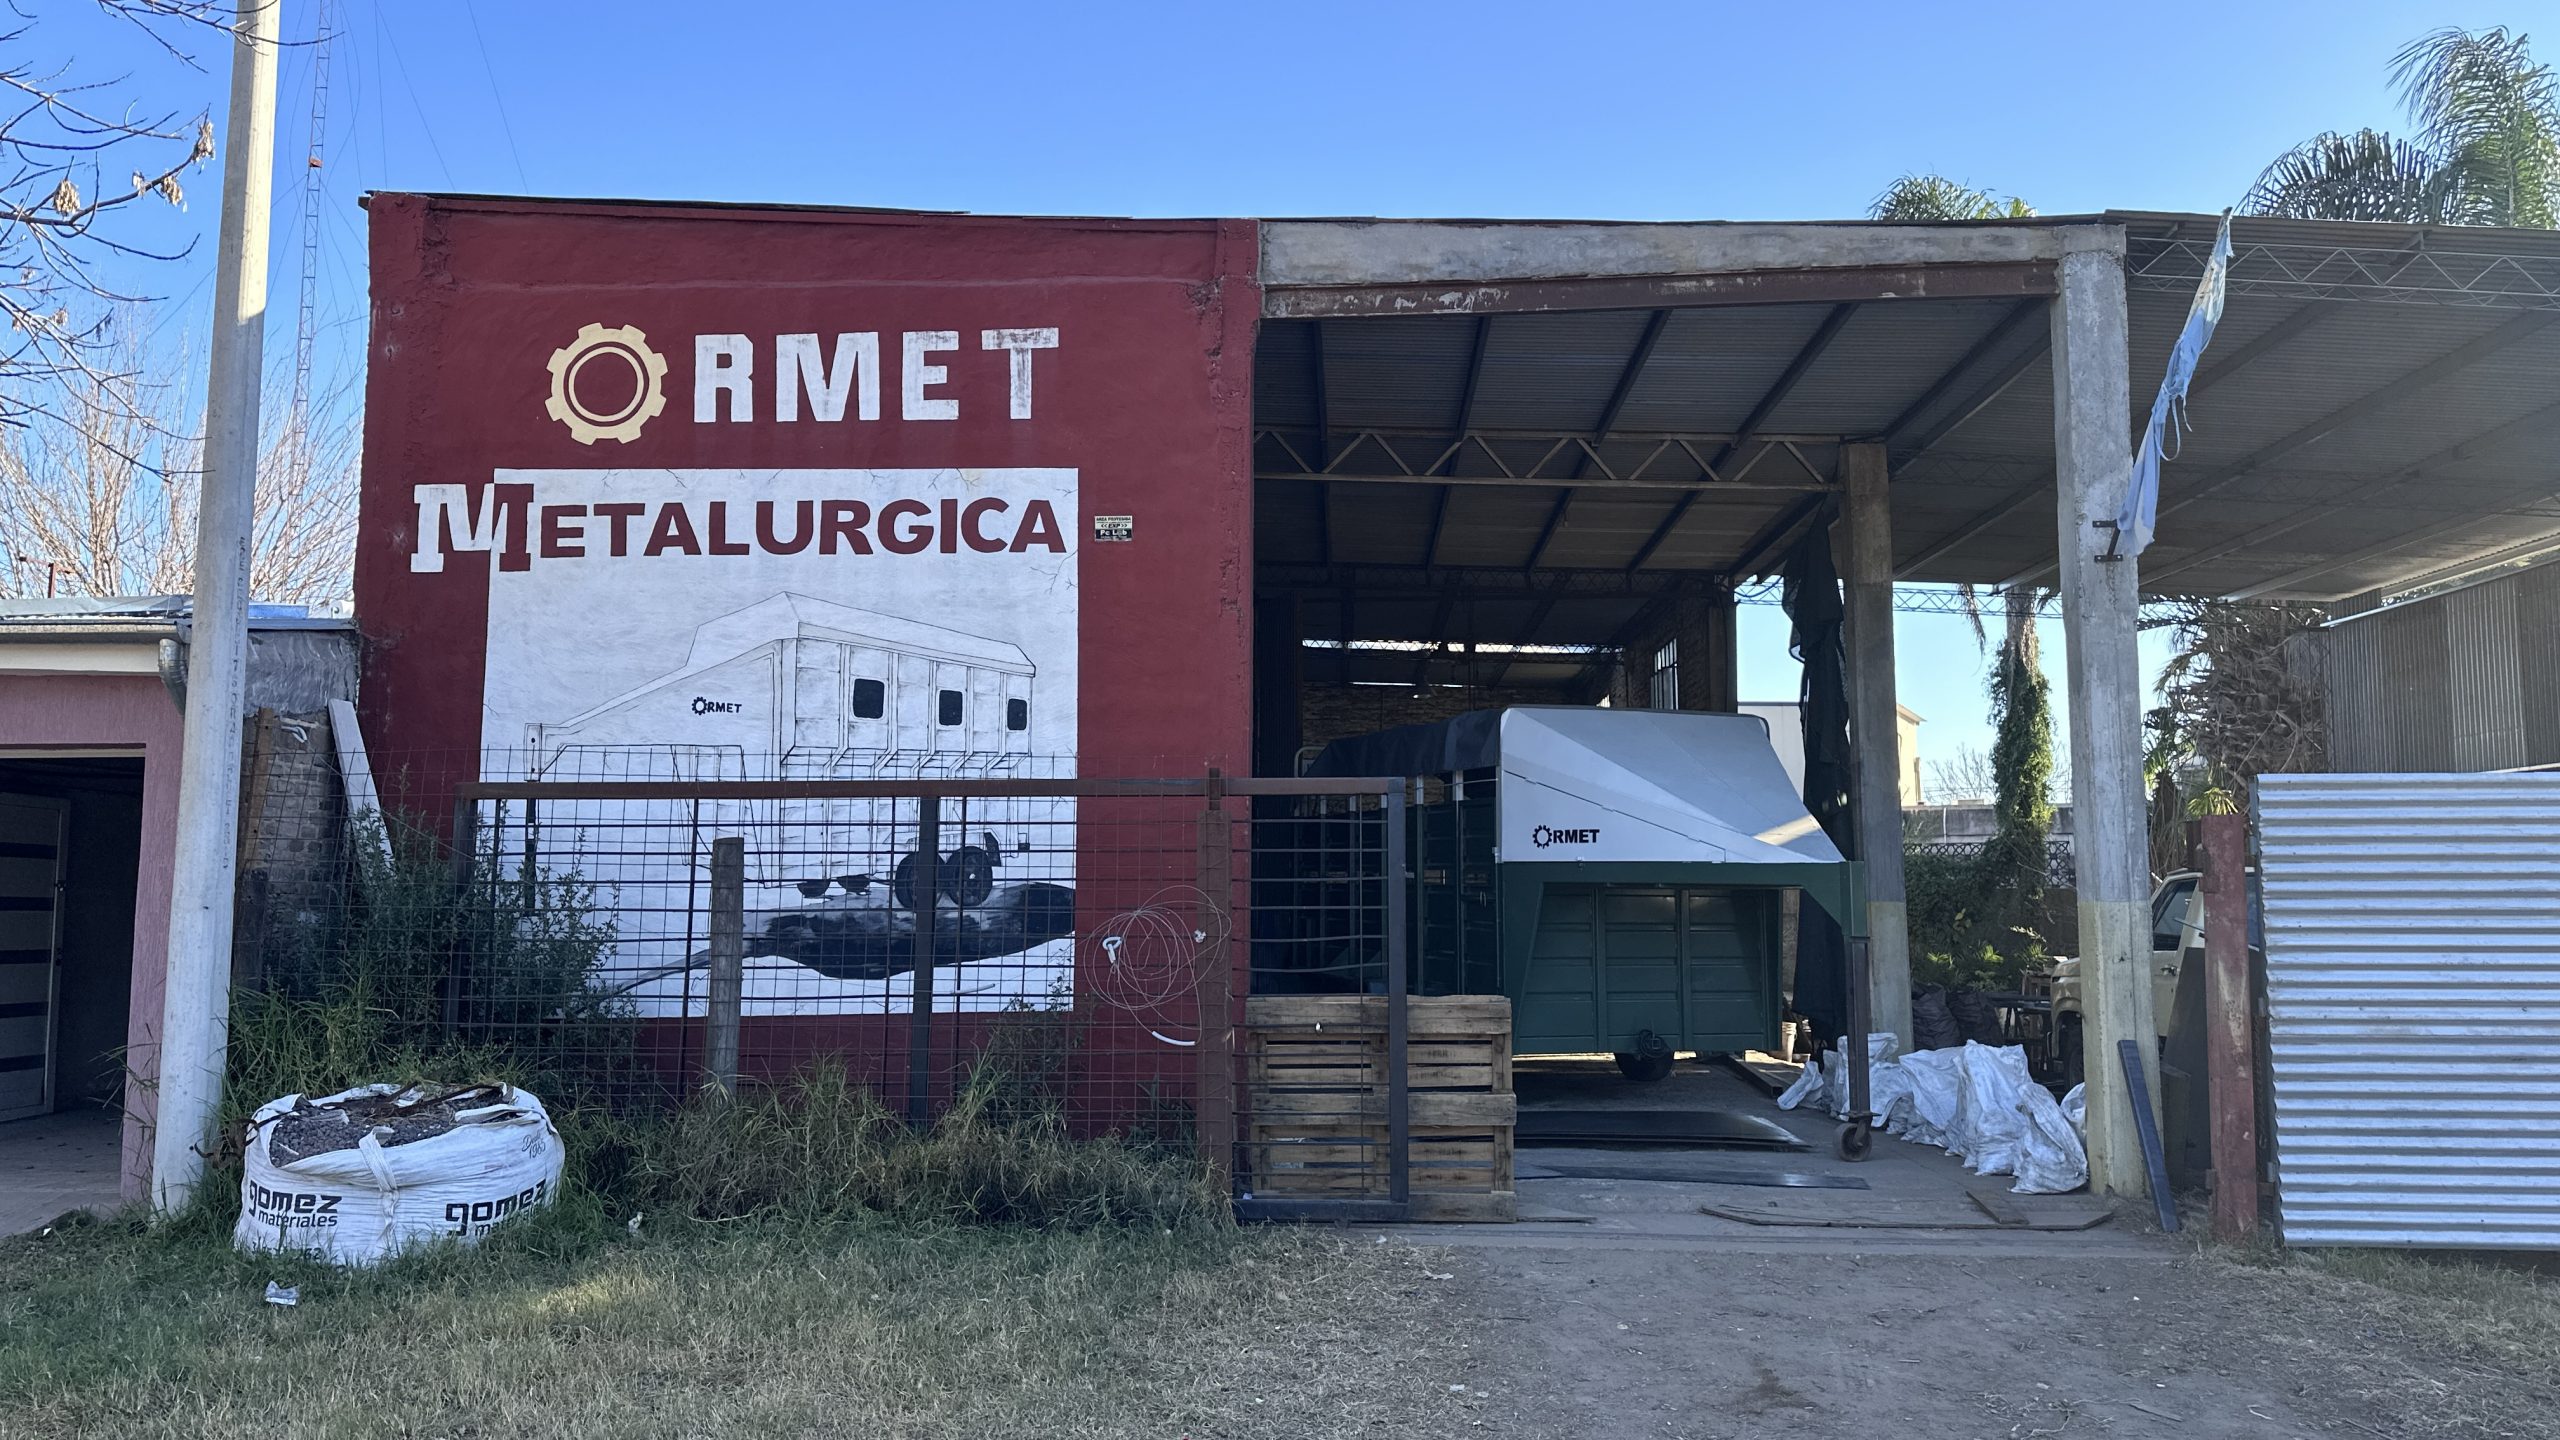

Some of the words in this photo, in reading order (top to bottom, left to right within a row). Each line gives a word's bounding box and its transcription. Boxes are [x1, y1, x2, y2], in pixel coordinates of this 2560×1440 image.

[410, 483, 1068, 573] METALURGICA
[248, 1180, 343, 1217] gomez
[258, 1209, 339, 1229] materiales
[445, 1179, 547, 1237] gomez
